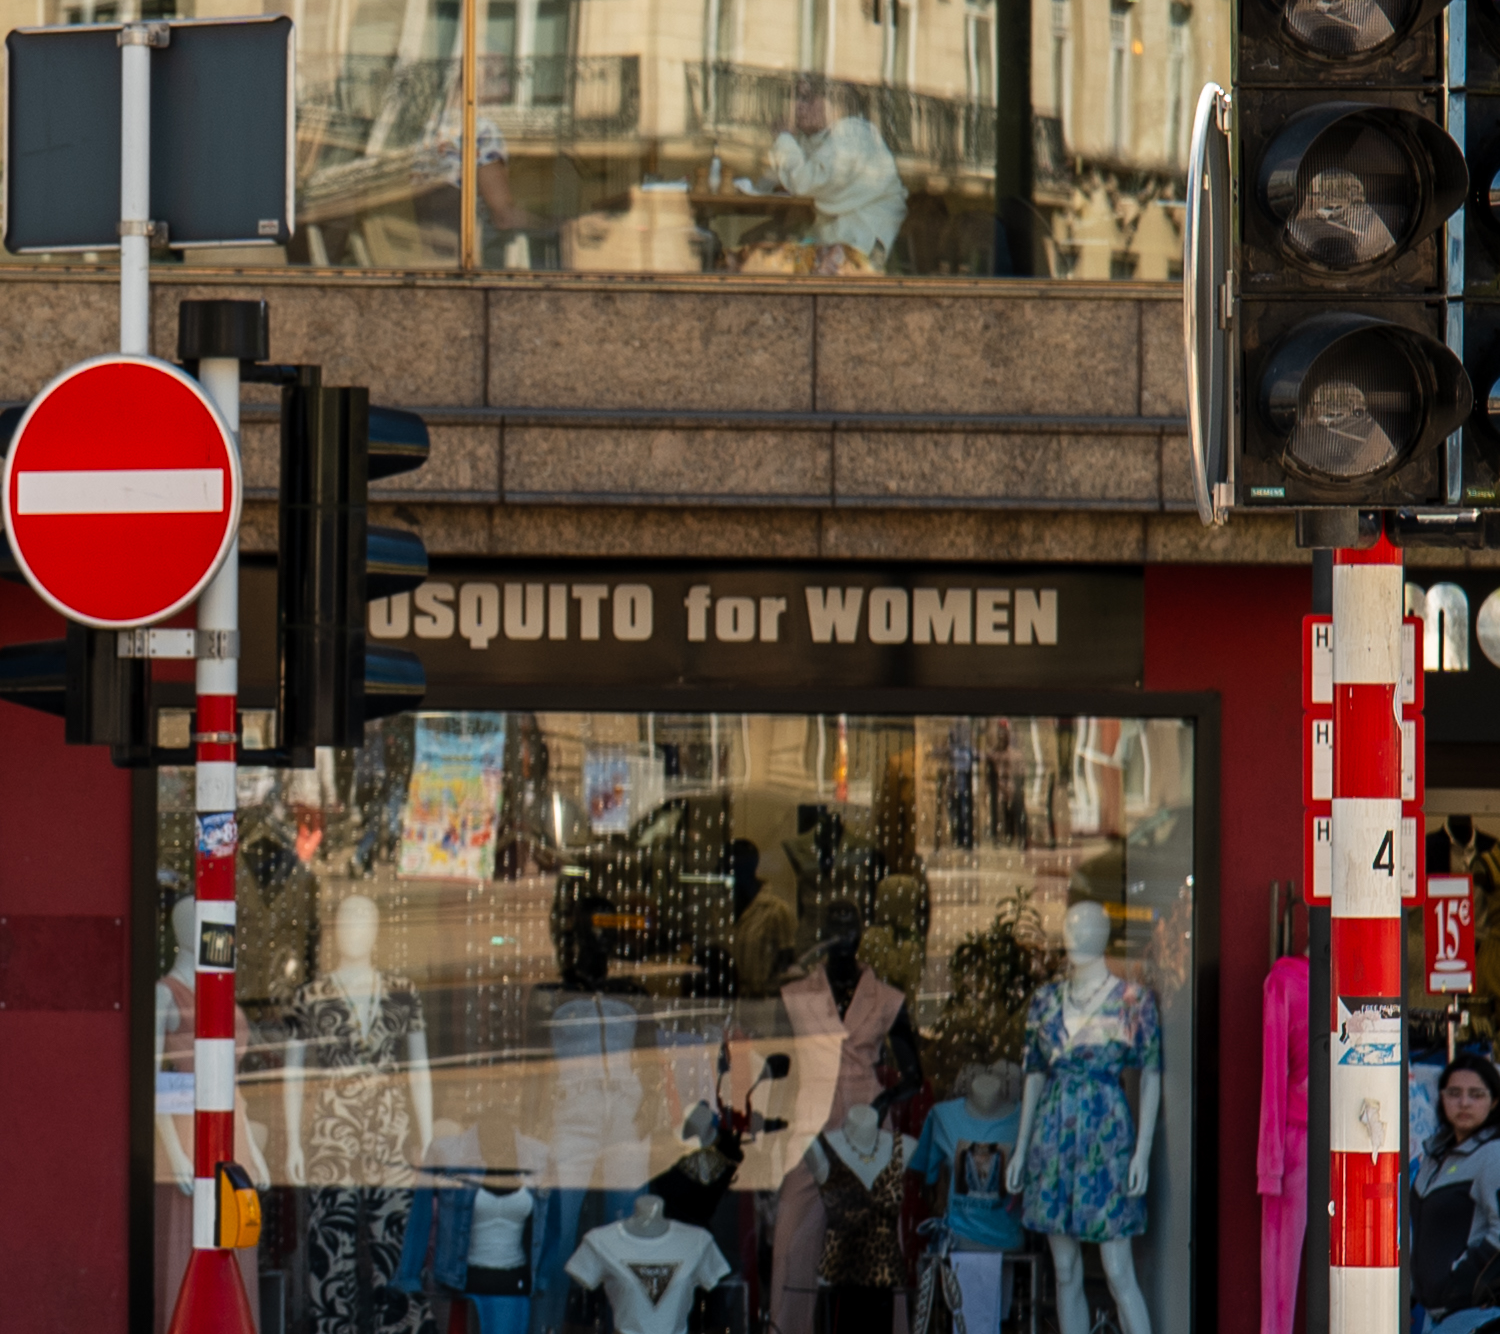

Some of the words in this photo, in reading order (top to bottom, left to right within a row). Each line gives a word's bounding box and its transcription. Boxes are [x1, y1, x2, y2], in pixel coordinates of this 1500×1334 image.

[368, 581, 654, 651] OSQUITO
[683, 583, 788, 644] for
[806, 586, 1059, 646] WOMEN
[1372, 829, 1395, 877] 4
[1433, 899, 1471, 963] 15€
